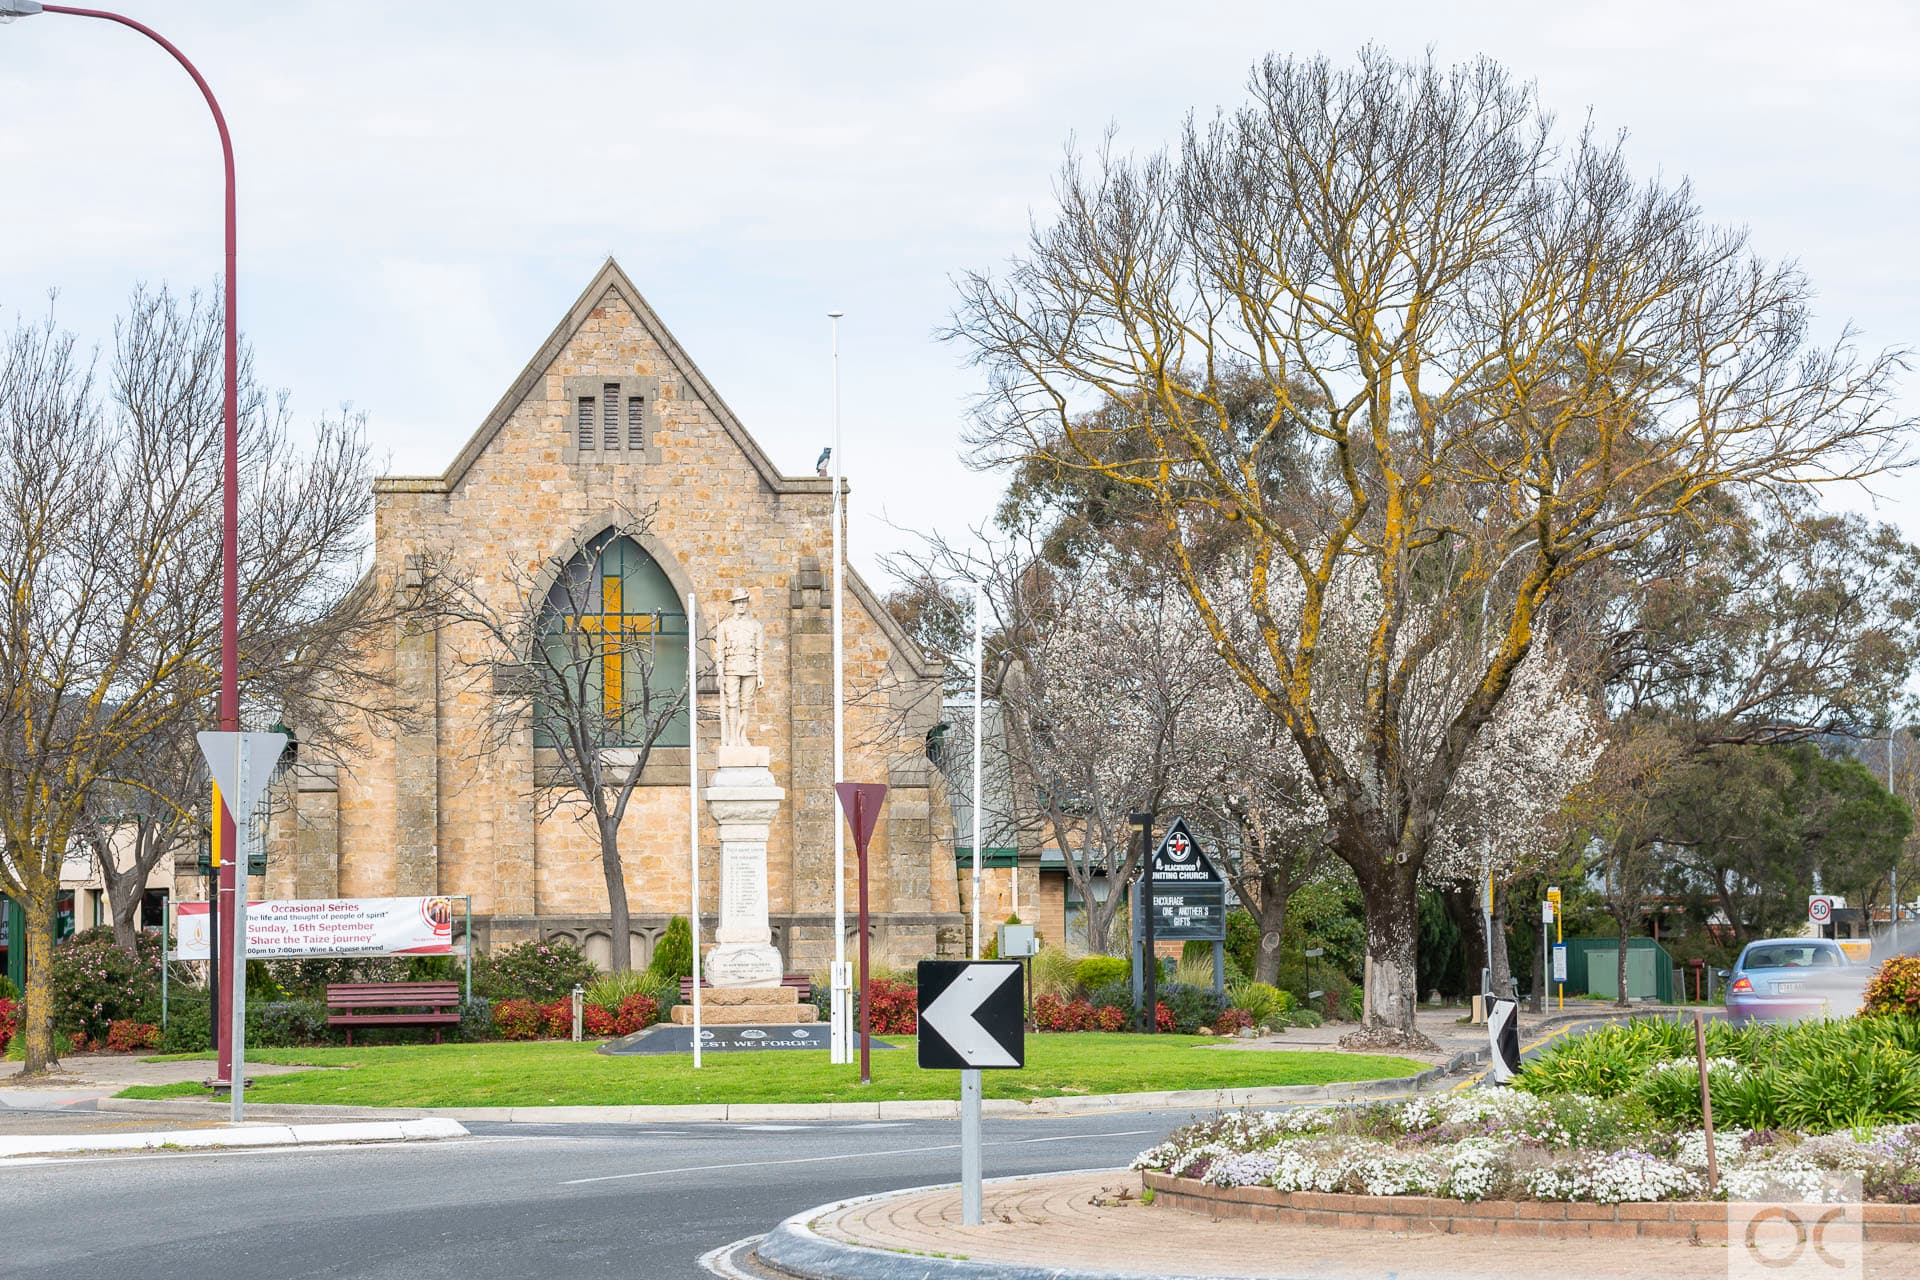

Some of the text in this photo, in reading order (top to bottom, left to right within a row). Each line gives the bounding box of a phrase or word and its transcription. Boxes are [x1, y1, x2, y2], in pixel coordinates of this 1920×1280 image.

[1178, 871, 1209, 880] CHURCH
[1153, 897, 1184, 906] ENCOURAGE
[271, 903, 360, 913] Occasional Series
[1162, 906, 1209, 916] ONE ANOTHER'S
[1813, 904, 1827, 915] 50
[260, 913, 272, 921] life
[273, 913, 288, 921] and
[289, 913, 319, 922] thought
[330, 912, 355, 922] people
[1173, 916, 1191, 927] GIFTS
[248, 922, 375, 934] Sunday, 16th September
[246, 936, 281, 945] "Share
[286, 935, 300, 945] the
[303, 935, 330, 944] Taize
[277, 946, 303, 955] 7:00pm
[361, 944, 384, 952] served
